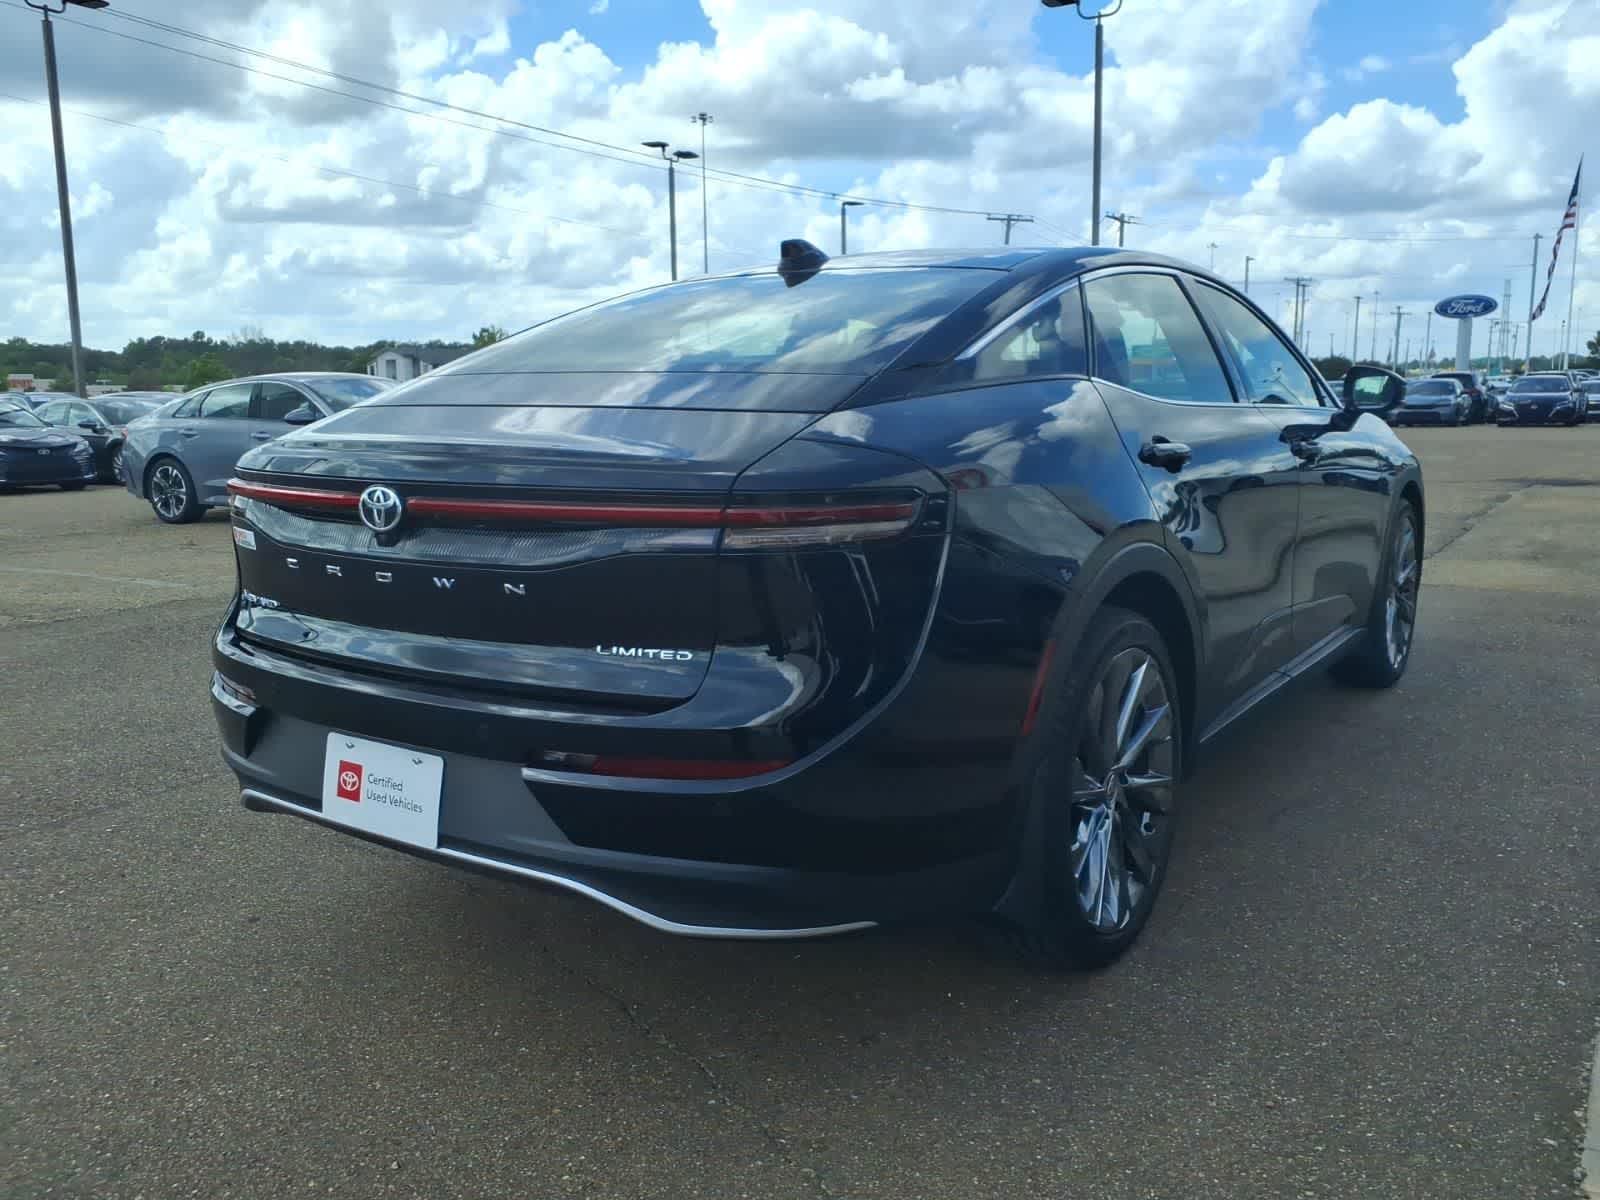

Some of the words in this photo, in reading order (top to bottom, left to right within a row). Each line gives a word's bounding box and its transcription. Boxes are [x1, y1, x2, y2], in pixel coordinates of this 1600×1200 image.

[1447, 299, 1485, 314] Ford
[286, 558, 526, 596] CROWN
[596, 645, 693, 661] LIMITED
[367, 773, 403, 791] Certified
[366, 789, 387, 804] Used
[389, 795, 423, 813] Vehicles
